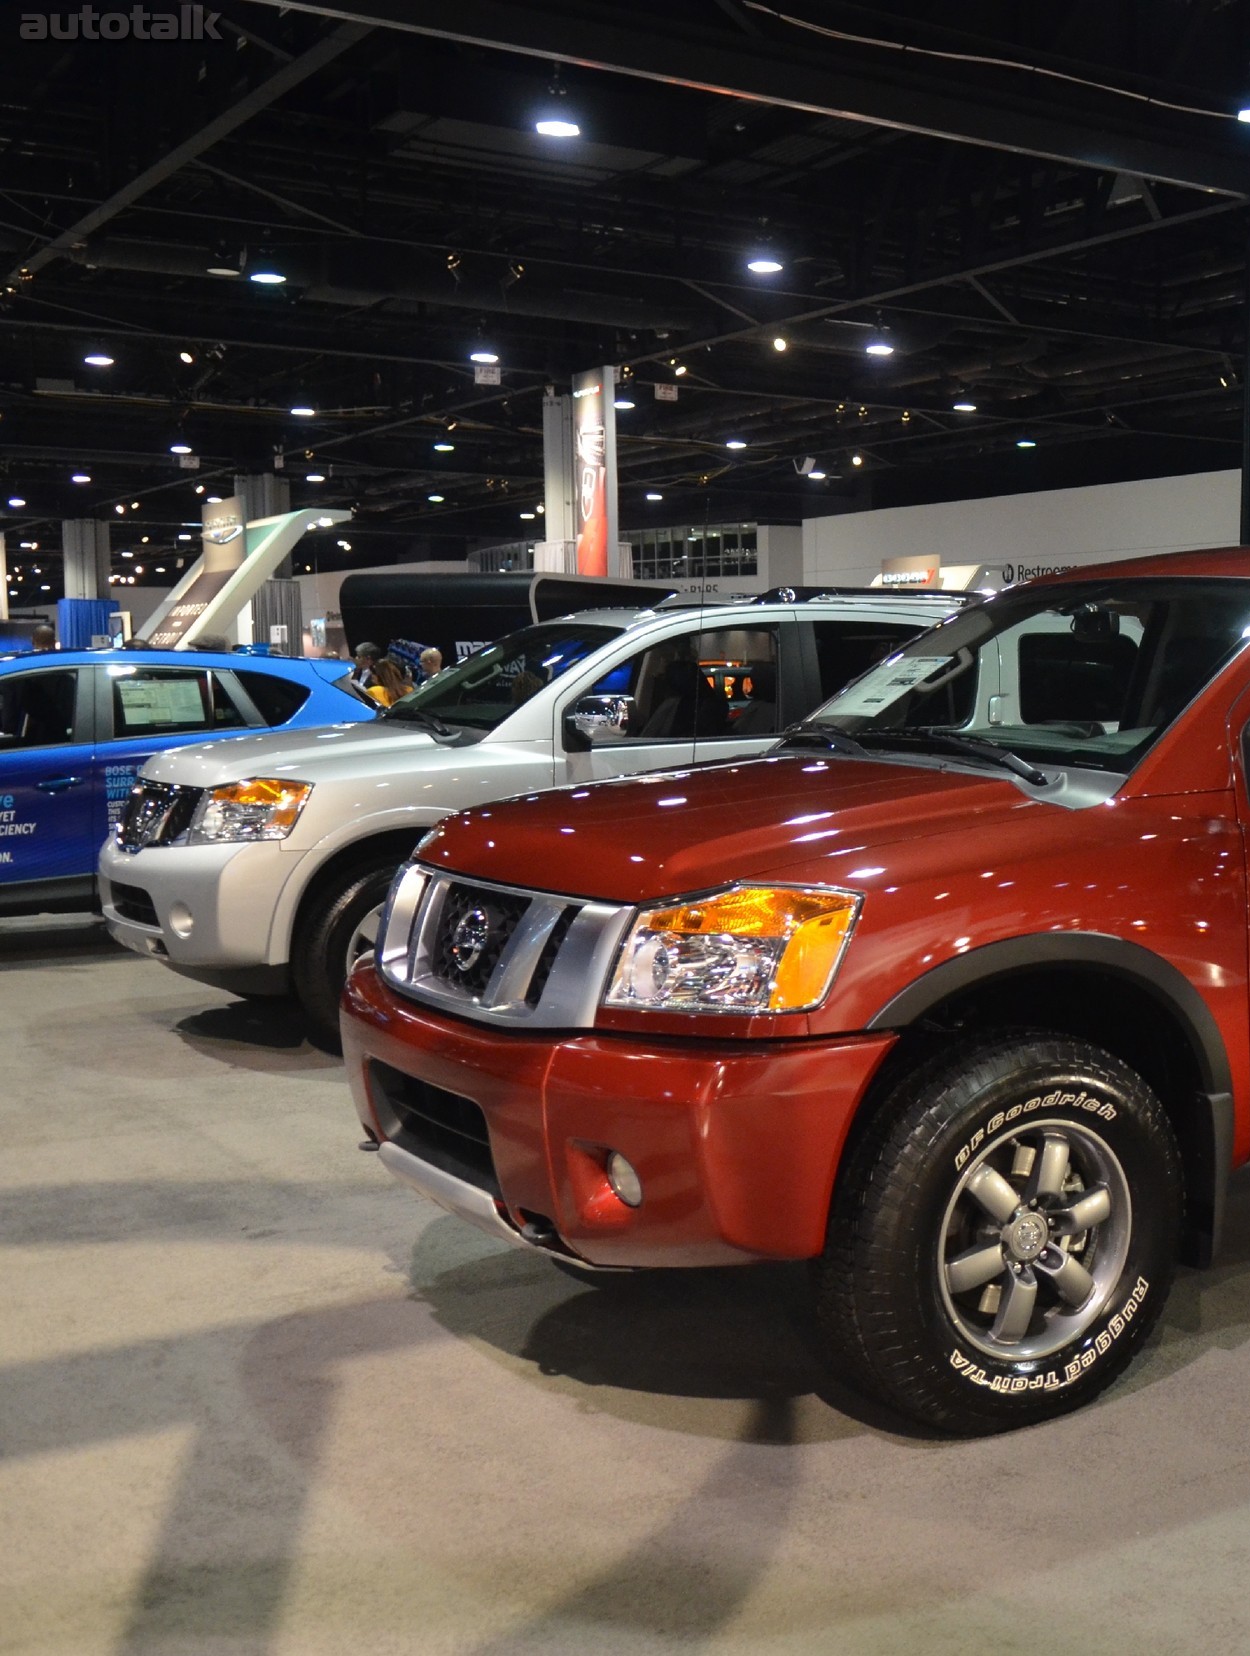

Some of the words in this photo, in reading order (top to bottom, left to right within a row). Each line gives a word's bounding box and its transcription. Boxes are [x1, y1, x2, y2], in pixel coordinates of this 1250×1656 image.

[1017, 565, 1077, 581] Restroo
[105, 765, 132, 776] BOSE
[1064, 1276, 1149, 1384] Rugged
[950, 1349, 988, 1385] T/A
[990, 1371, 1060, 1393] Trail
